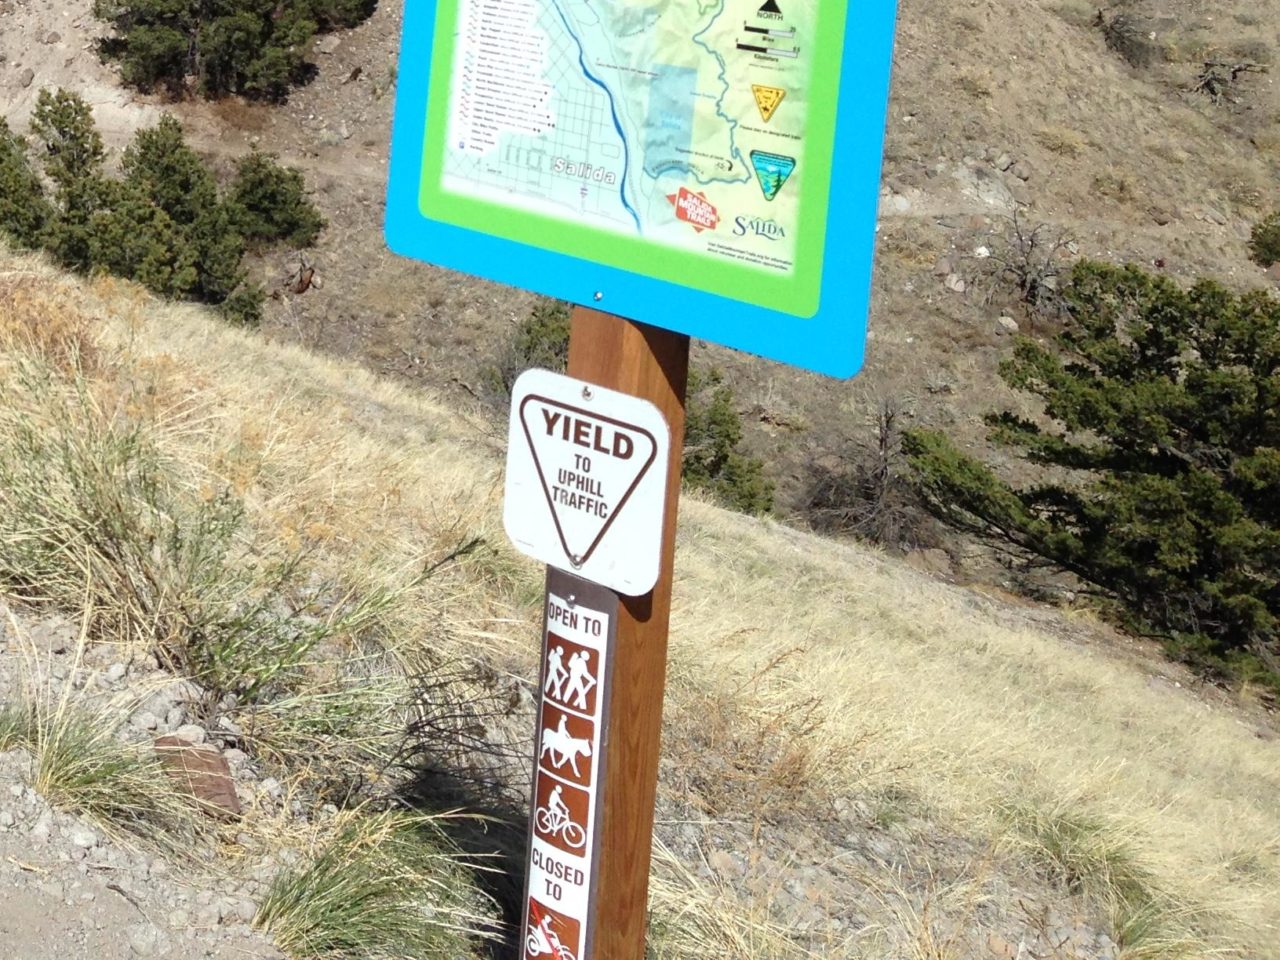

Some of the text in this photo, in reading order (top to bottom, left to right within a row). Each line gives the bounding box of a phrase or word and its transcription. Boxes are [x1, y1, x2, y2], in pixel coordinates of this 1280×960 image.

[757, 11, 783, 21] NORTH
[553, 157, 616, 185] Salida
[732, 216, 786, 241] SALIDA
[541, 408, 634, 460] YIELD
[574, 454, 591, 473] TO
[558, 468, 604, 498] UPHILL
[552, 485, 608, 519] TRAFFIC
[549, 602, 601, 637] OPEN TO
[532, 847, 585, 886] CLOSED
[544, 878, 562, 901] TO
